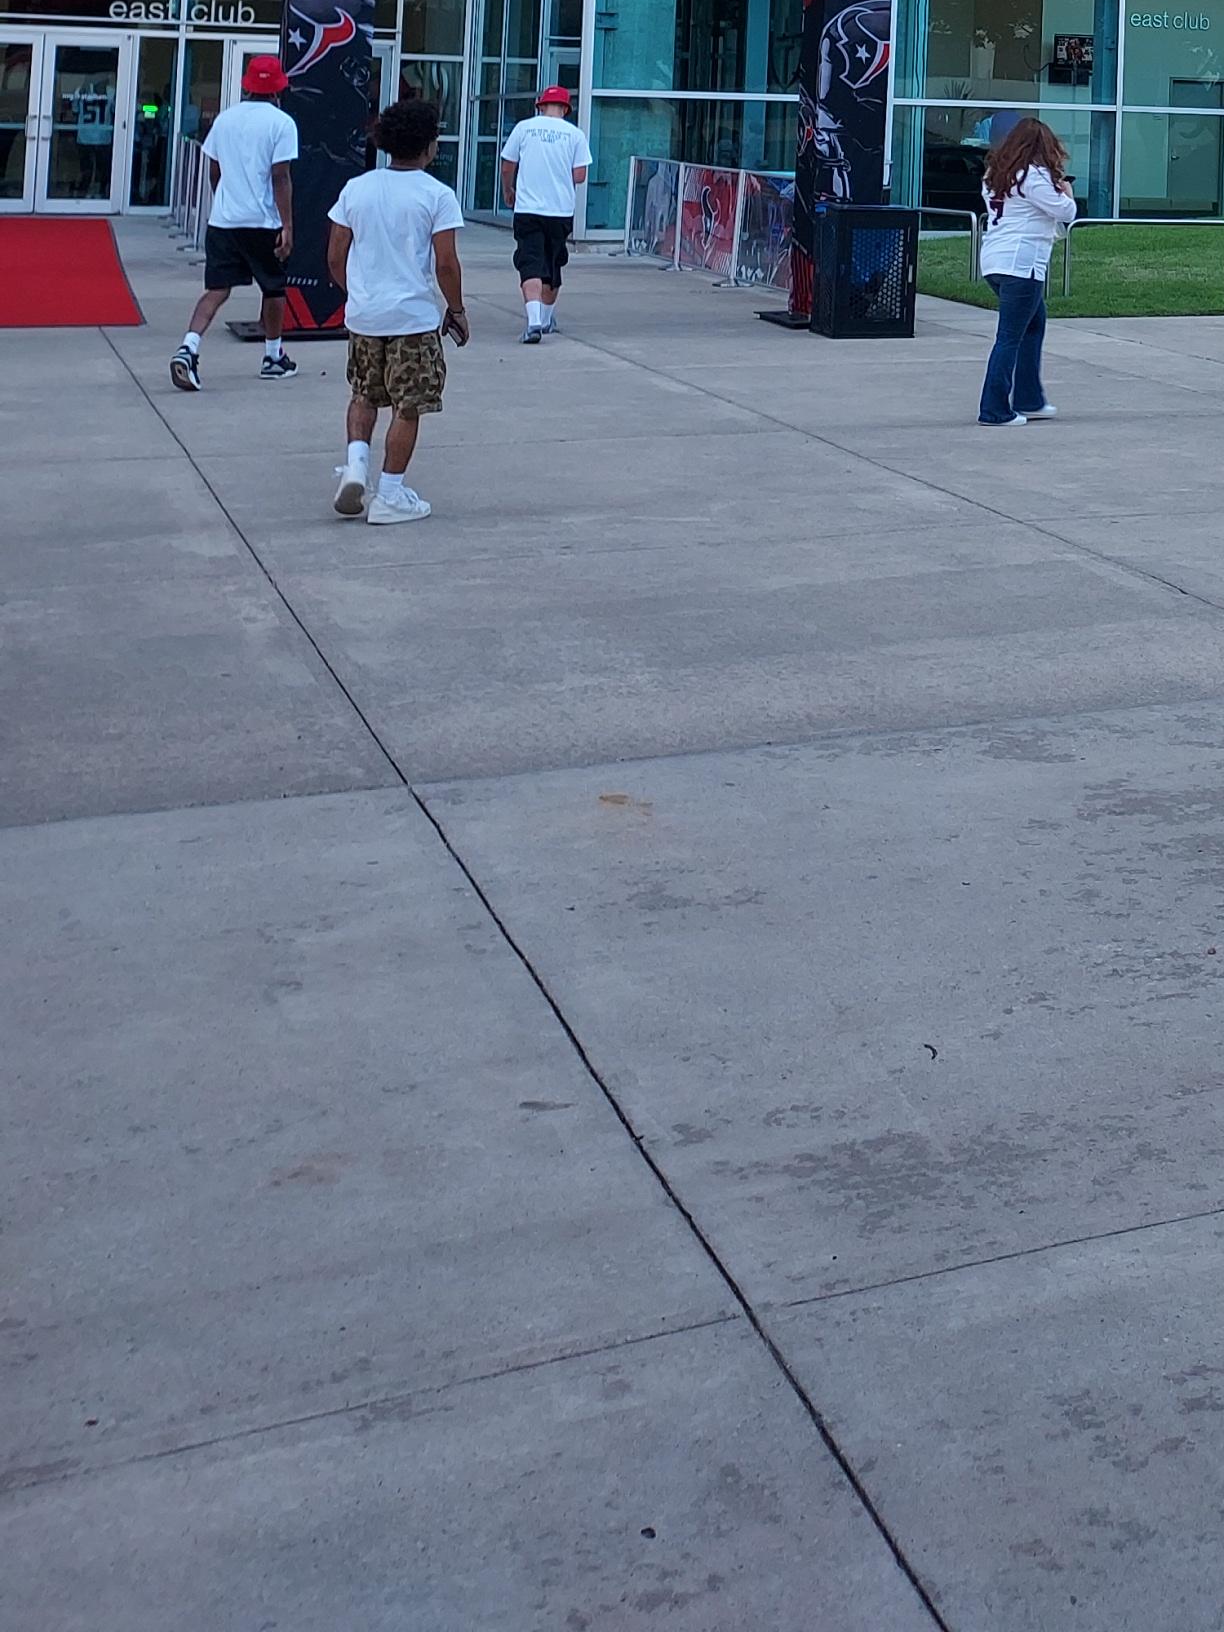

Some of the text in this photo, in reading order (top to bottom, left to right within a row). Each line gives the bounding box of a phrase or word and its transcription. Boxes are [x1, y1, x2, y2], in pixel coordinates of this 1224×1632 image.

[190, 0, 256, 24] club
[1129, 11, 1211, 30] east club
